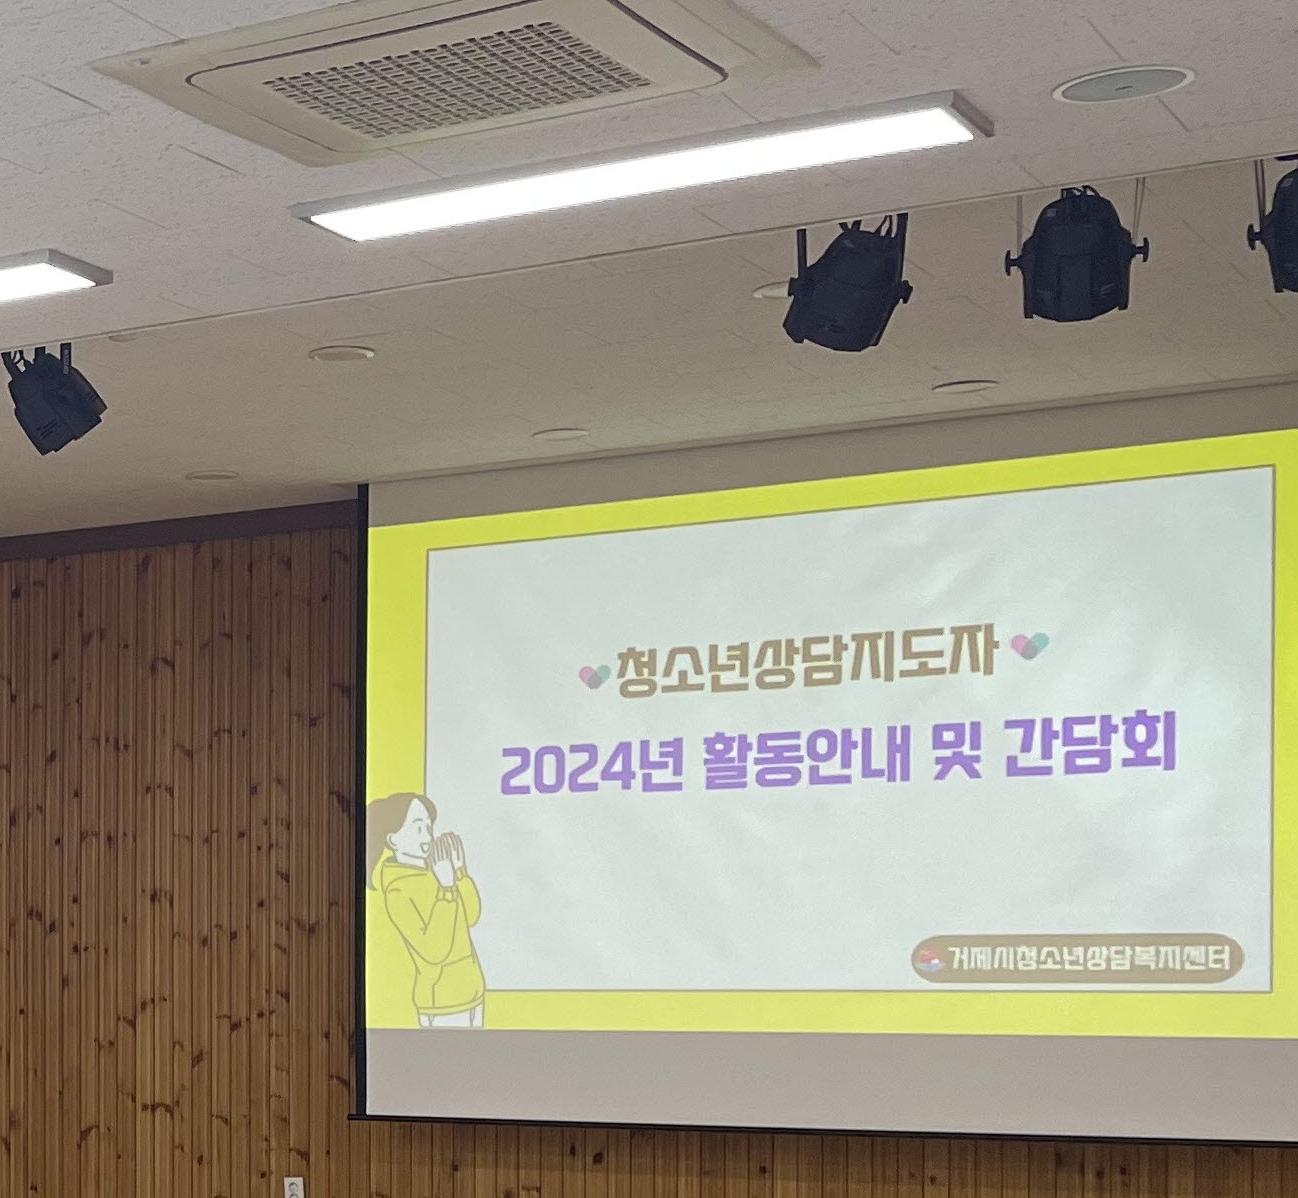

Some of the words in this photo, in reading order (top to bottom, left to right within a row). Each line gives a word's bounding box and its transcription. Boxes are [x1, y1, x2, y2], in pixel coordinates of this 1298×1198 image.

[616, 623, 1000, 699] 청소년상담지도자
[501, 737, 684, 796] 2024년
[703, 725, 911, 791] 활동안내
[931, 720, 983, 781] 및
[1003, 709, 1177, 778] 간담회
[947, 945, 1232, 971] 거제시청소년상담복지센터
